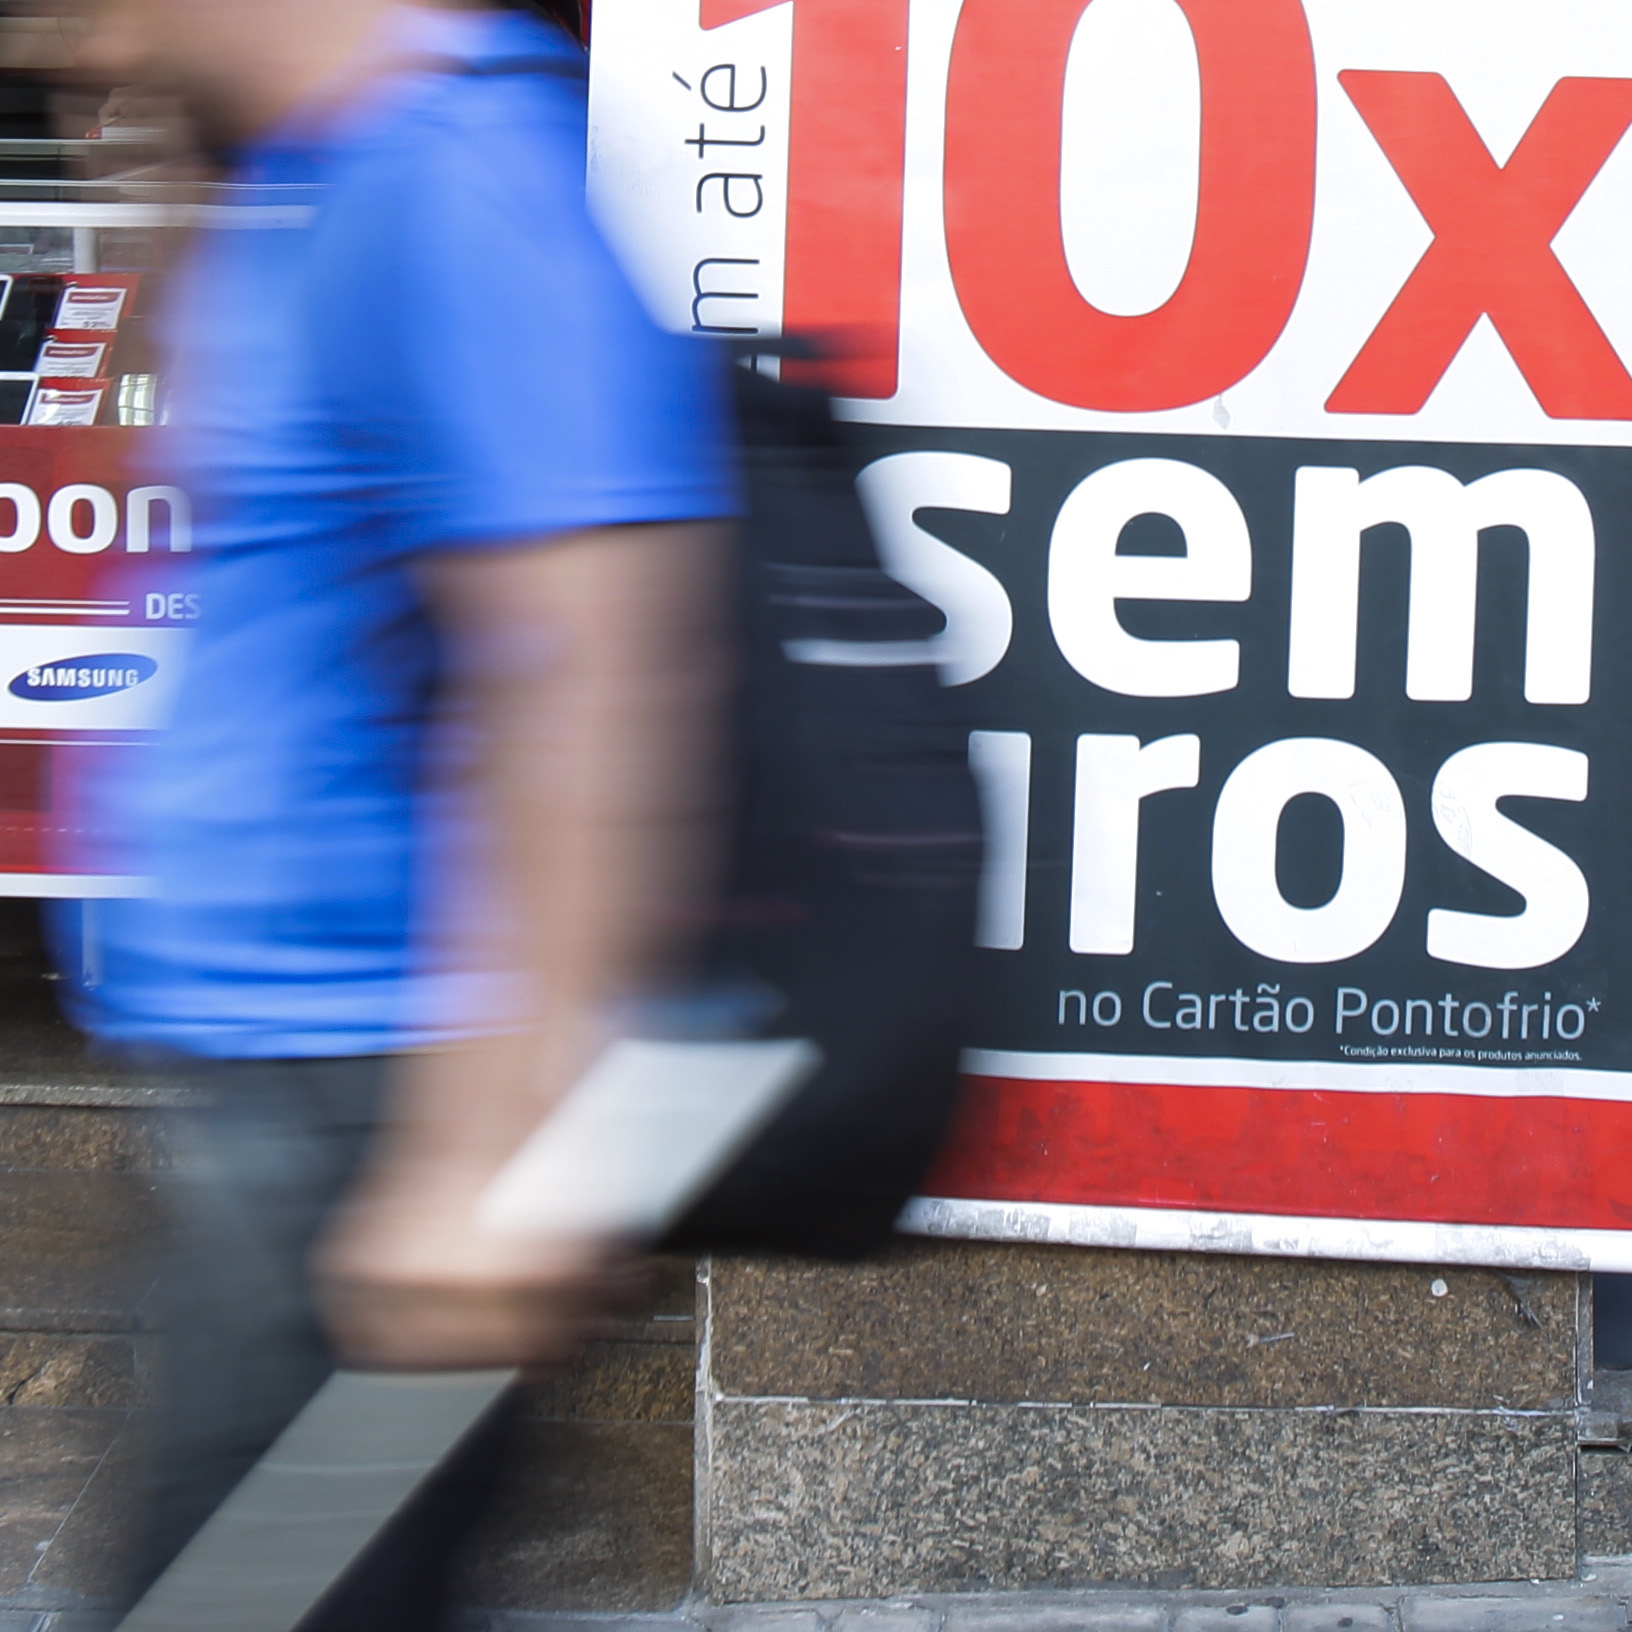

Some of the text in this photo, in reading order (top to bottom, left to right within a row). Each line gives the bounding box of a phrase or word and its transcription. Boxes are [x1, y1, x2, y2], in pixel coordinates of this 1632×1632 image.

[672, 63, 768, 218] até
[856, 451, 1596, 705] sem
[26, 667, 140, 688] SAMSUNG
[1058, 990, 1122, 1027] no
[1142, 980, 1315, 1033] Cartão
[1390, 1046, 1438, 1058] exclusiva
[1439, 1047, 1462, 1060] para
[1463, 1049, 1476, 1060] os
[1477, 1049, 1523, 1062] produtos
[1524, 1050, 1583, 1062] anunciados.
